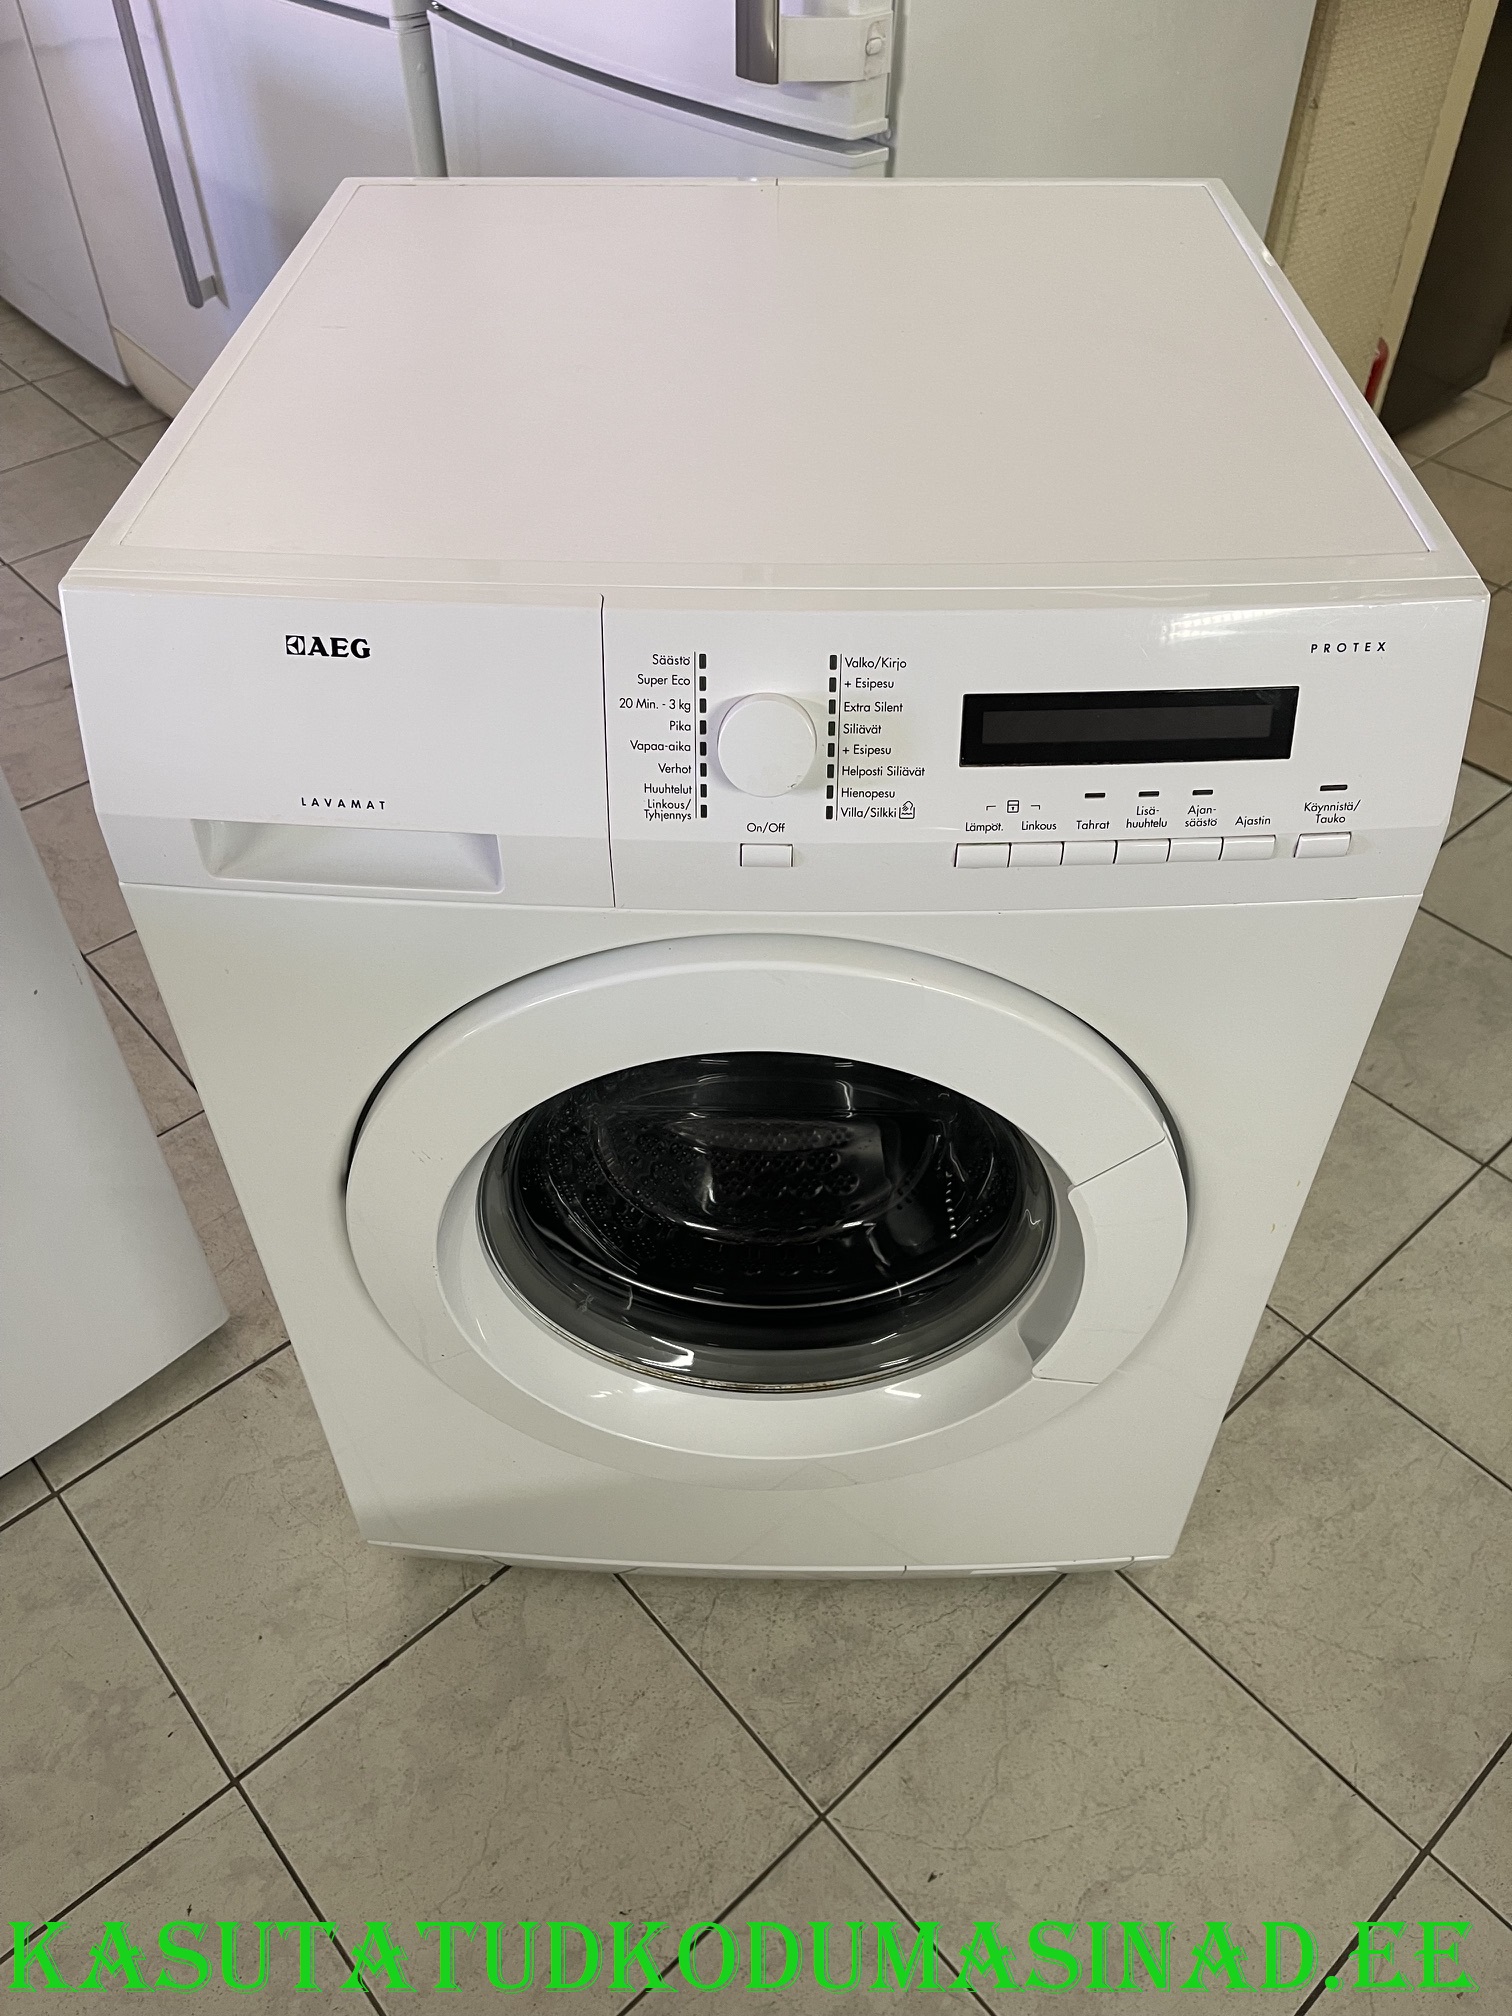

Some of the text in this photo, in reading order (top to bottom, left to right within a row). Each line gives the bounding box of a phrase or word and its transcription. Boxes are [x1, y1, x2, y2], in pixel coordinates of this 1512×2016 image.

[307, 637, 371, 659] AEG
[1311, 642, 1387, 654] PROTEX
[653, 654, 691, 666] Säästö
[845, 656, 907, 672] Valko/Kirjo
[638, 674, 691, 688] Super Eco
[856, 678, 895, 692] Esipesu
[620, 698, 634, 709] 20
[636, 698, 659, 710] Min.
[669, 699, 676, 710] 3
[679, 699, 691, 714] kg
[844, 701, 904, 713] Extra Silent
[670, 720, 692, 732] Pika
[843, 723, 882, 735] Siliävät
[630, 740, 692, 754] Vapaa-aika
[854, 744, 892, 758] Esipesu
[658, 763, 692, 775] Verhot
[842, 765, 926, 779] Helposti Siliävät
[644, 783, 693, 795] Huuhtelut
[842, 787, 896, 801] Hienopesu
[302, 797, 386, 811] LAVAMAT
[647, 799, 691, 811] Linkous/
[1136, 805, 1160, 816] Lisä-
[1187, 804, 1217, 817] Ajan-
[1304, 800, 1361, 815] Käynnistä/
[644, 808, 692, 822] Tyhjennys
[841, 806, 897, 819] Villa/Silkki
[1316, 811, 1346, 824] Tauko
[747, 822, 786, 834] On/Off
[1022, 820, 1057, 831] Linkous
[1076, 820, 1110, 830] Tahrat
[1126, 816, 1168, 829] huuhtelu
[1184, 815, 1217, 828] säästö
[1235, 816, 1271, 829] Ajastin
[966, 822, 1004, 835] Lämpöt.
